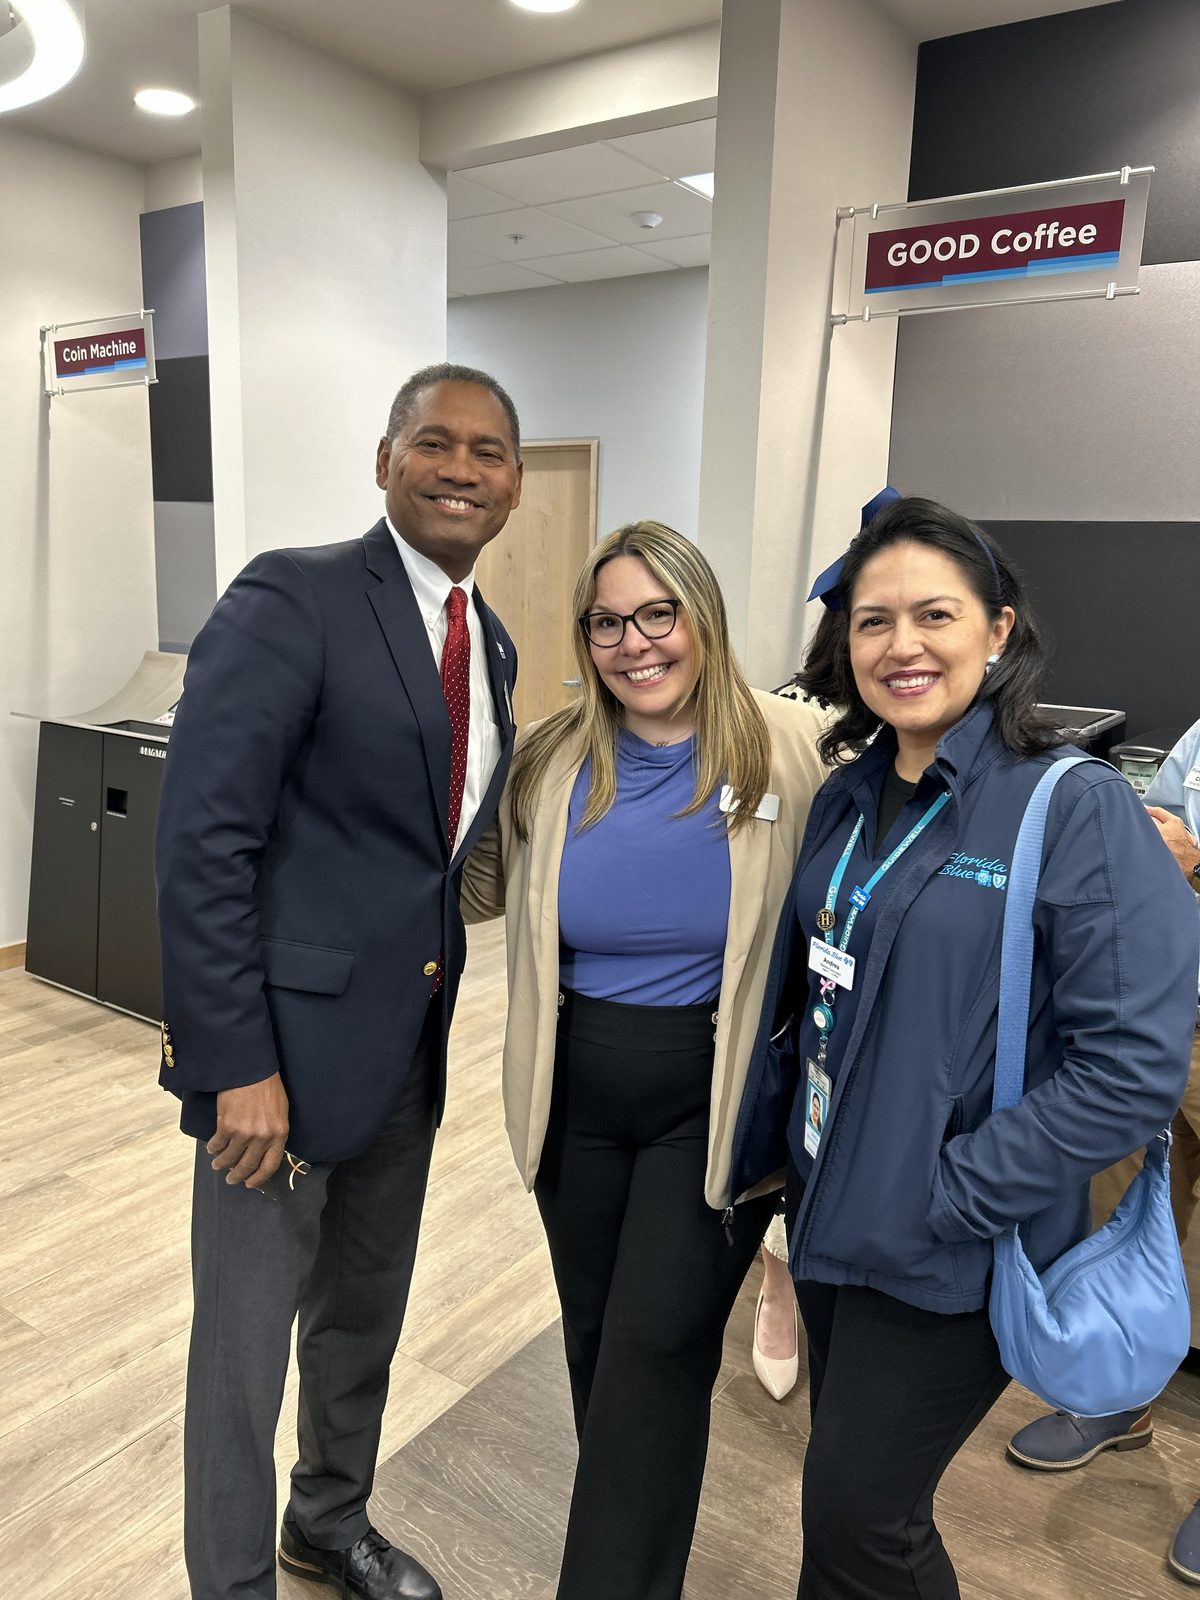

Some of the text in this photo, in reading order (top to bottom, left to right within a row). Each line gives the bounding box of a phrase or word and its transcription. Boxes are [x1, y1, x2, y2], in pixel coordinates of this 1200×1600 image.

[887, 221, 1097, 267] GOOD Coffee
[63, 340, 136, 362] Coin Machine
[881, 825, 926, 871] GUIDEWELL
[937, 864, 974, 879] Blue
[839, 906, 859, 952] GUIDEWE
